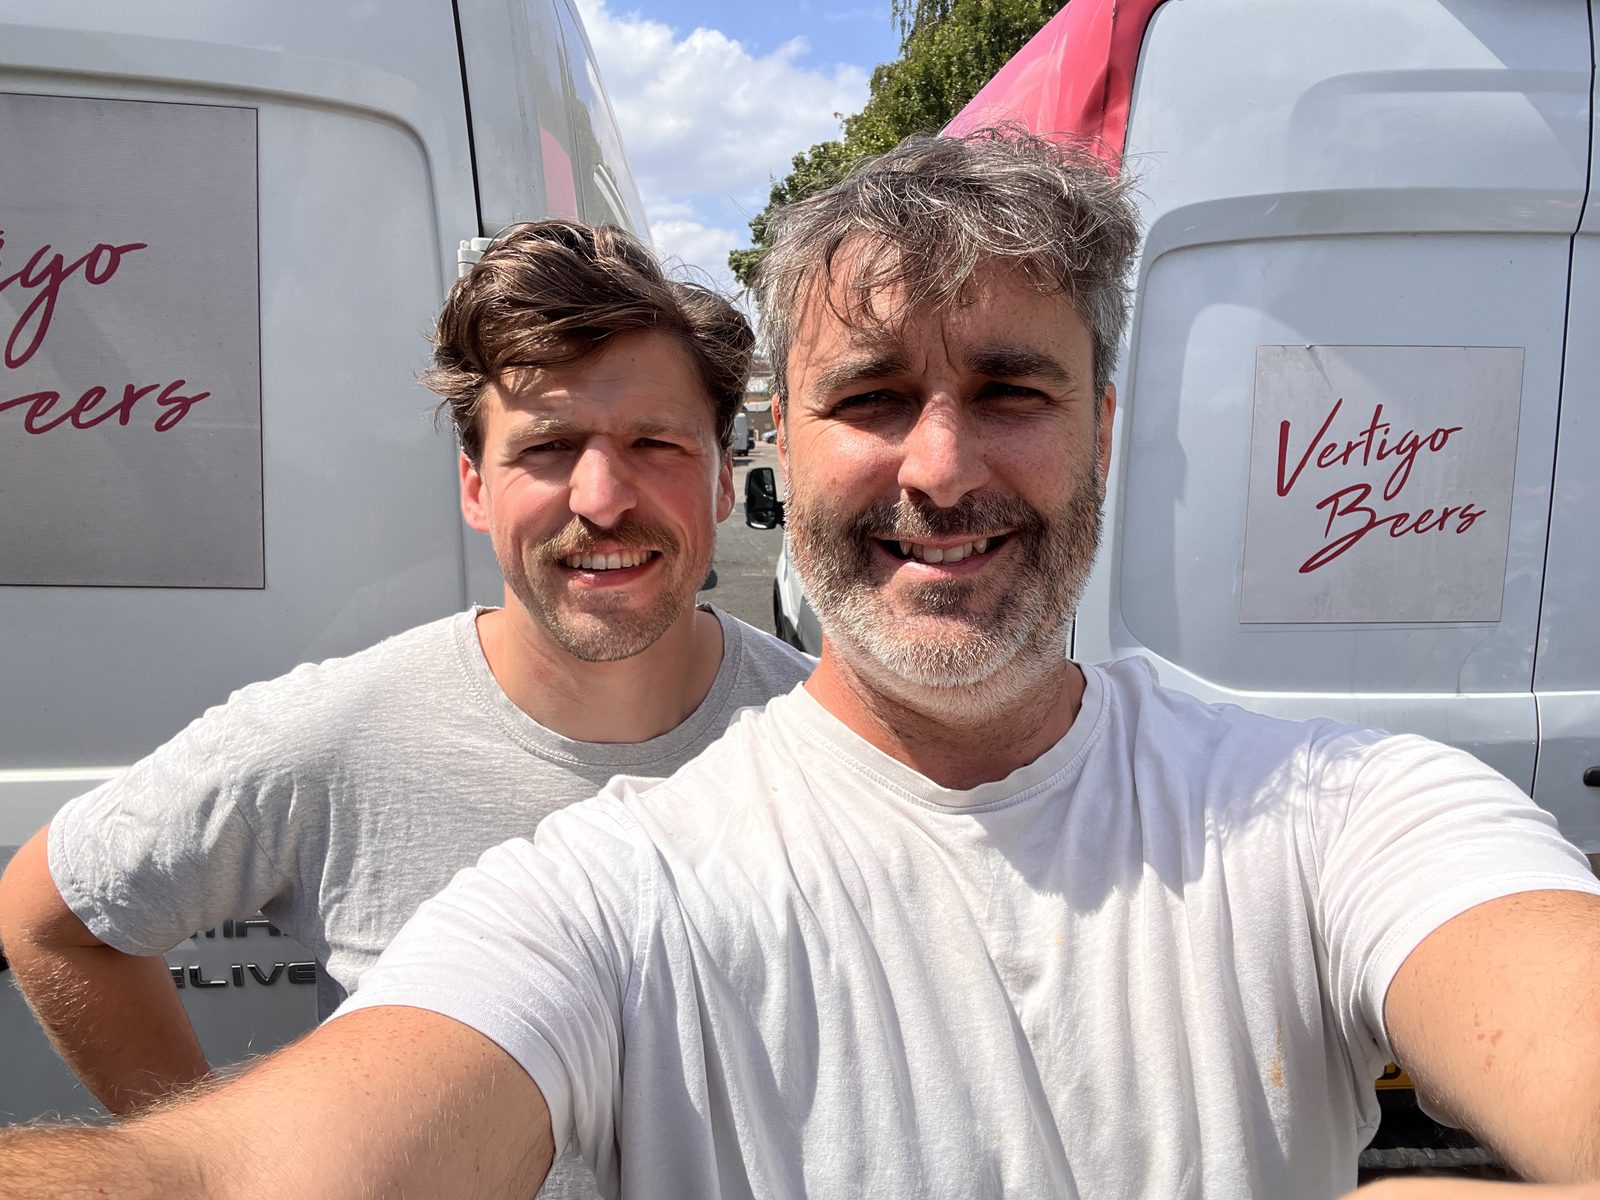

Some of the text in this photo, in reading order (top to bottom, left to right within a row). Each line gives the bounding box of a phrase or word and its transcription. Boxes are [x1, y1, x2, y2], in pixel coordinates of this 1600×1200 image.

[0, 379, 211, 434] eers
[1276, 398, 1463, 501] Vertigo
[1298, 483, 1487, 573] Beers
